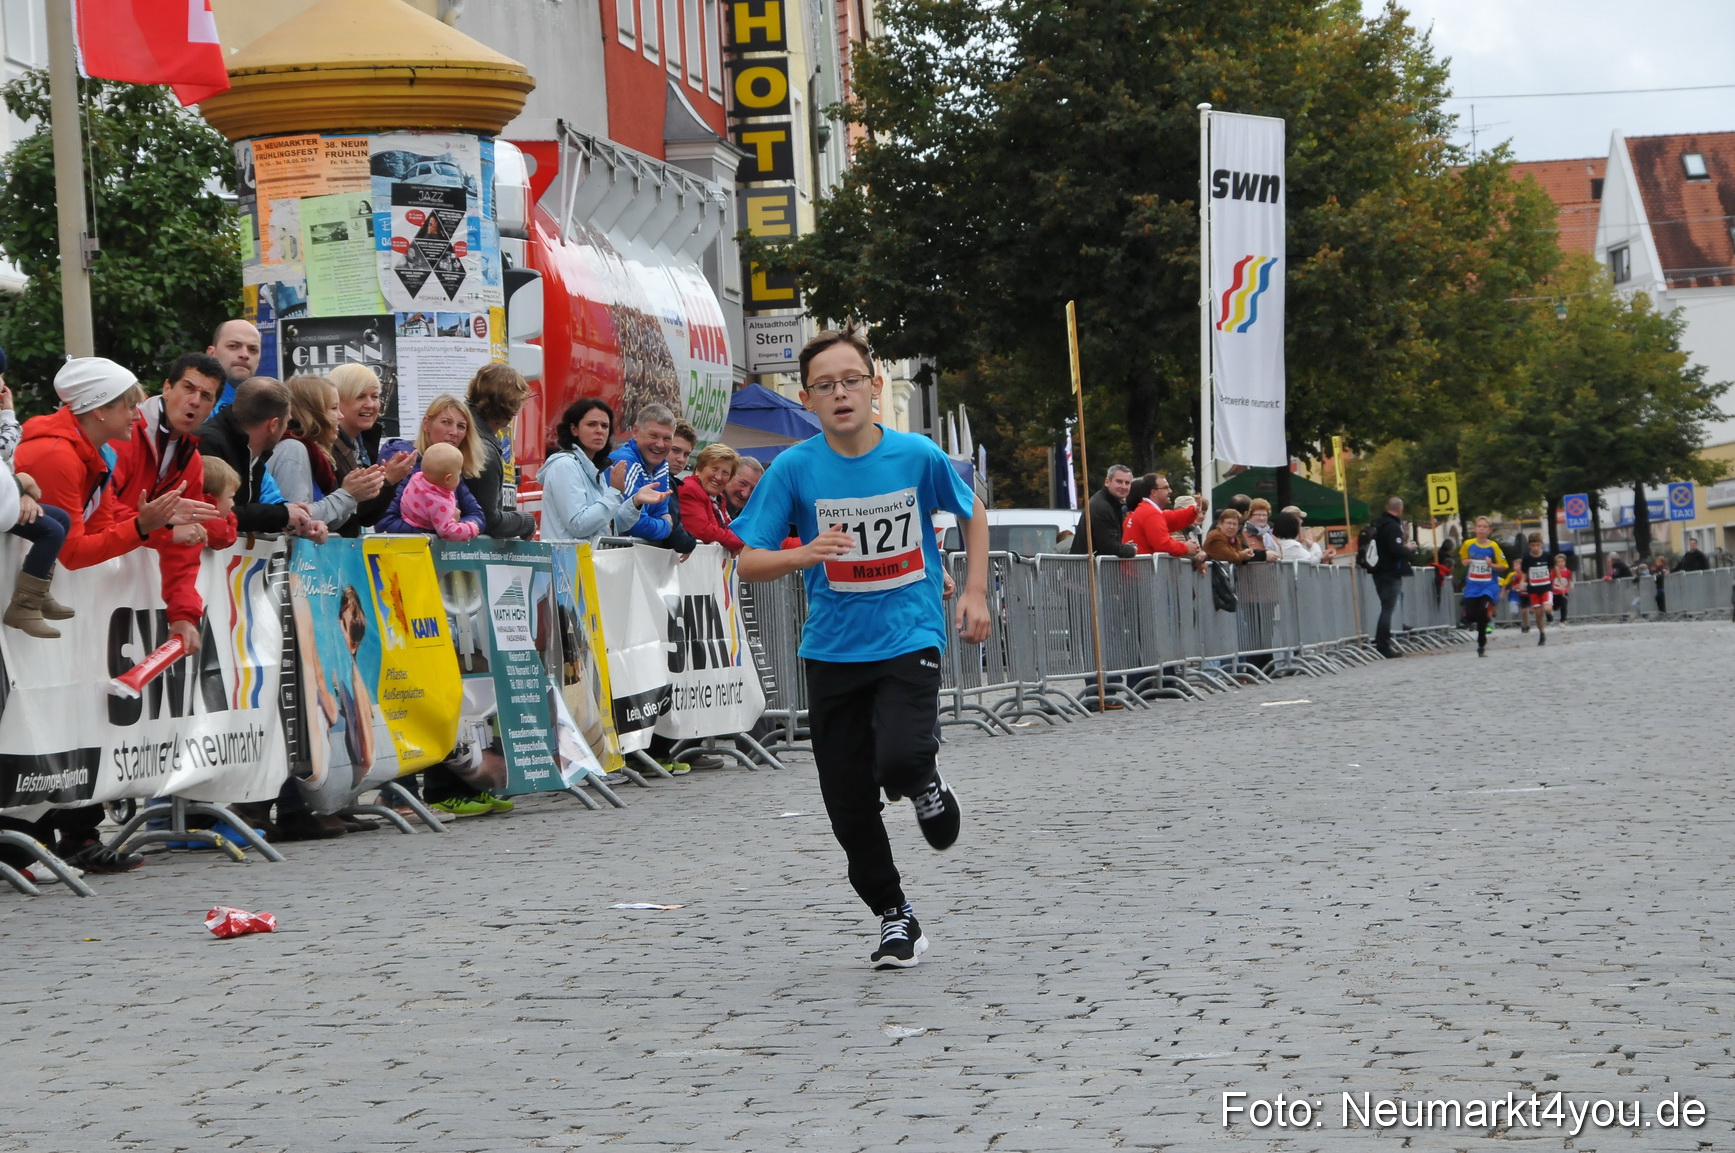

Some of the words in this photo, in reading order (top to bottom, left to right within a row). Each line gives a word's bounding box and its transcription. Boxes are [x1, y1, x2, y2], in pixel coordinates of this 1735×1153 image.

[264, 138, 318, 150] NEUMARKTER
[324, 141, 338, 149] 38.
[734, 2, 794, 300] HOTEL
[255, 147, 319, 161] FRÜHLINGSFEST
[418, 190, 444, 201] JAZZ
[682, 293, 729, 367] AVIA
[749, 319, 799, 330] Altstadthotel
[756, 333, 794, 345] Stern
[292, 343, 383, 367] GLENN
[684, 369, 727, 434] Pellets
[1436, 485, 1451, 506] D
[819, 508, 854, 518] PARTL
[855, 501, 903, 517] Neumarkt
[1671, 509, 1695, 519] TAXI
[1568, 517, 1588, 527] TAXI
[852, 562, 900, 579] Maxim
[385, 667, 409, 681] Pflaster
[383, 686, 425, 703] Außenplatten
[185, 722, 265, 769] neumarkt
